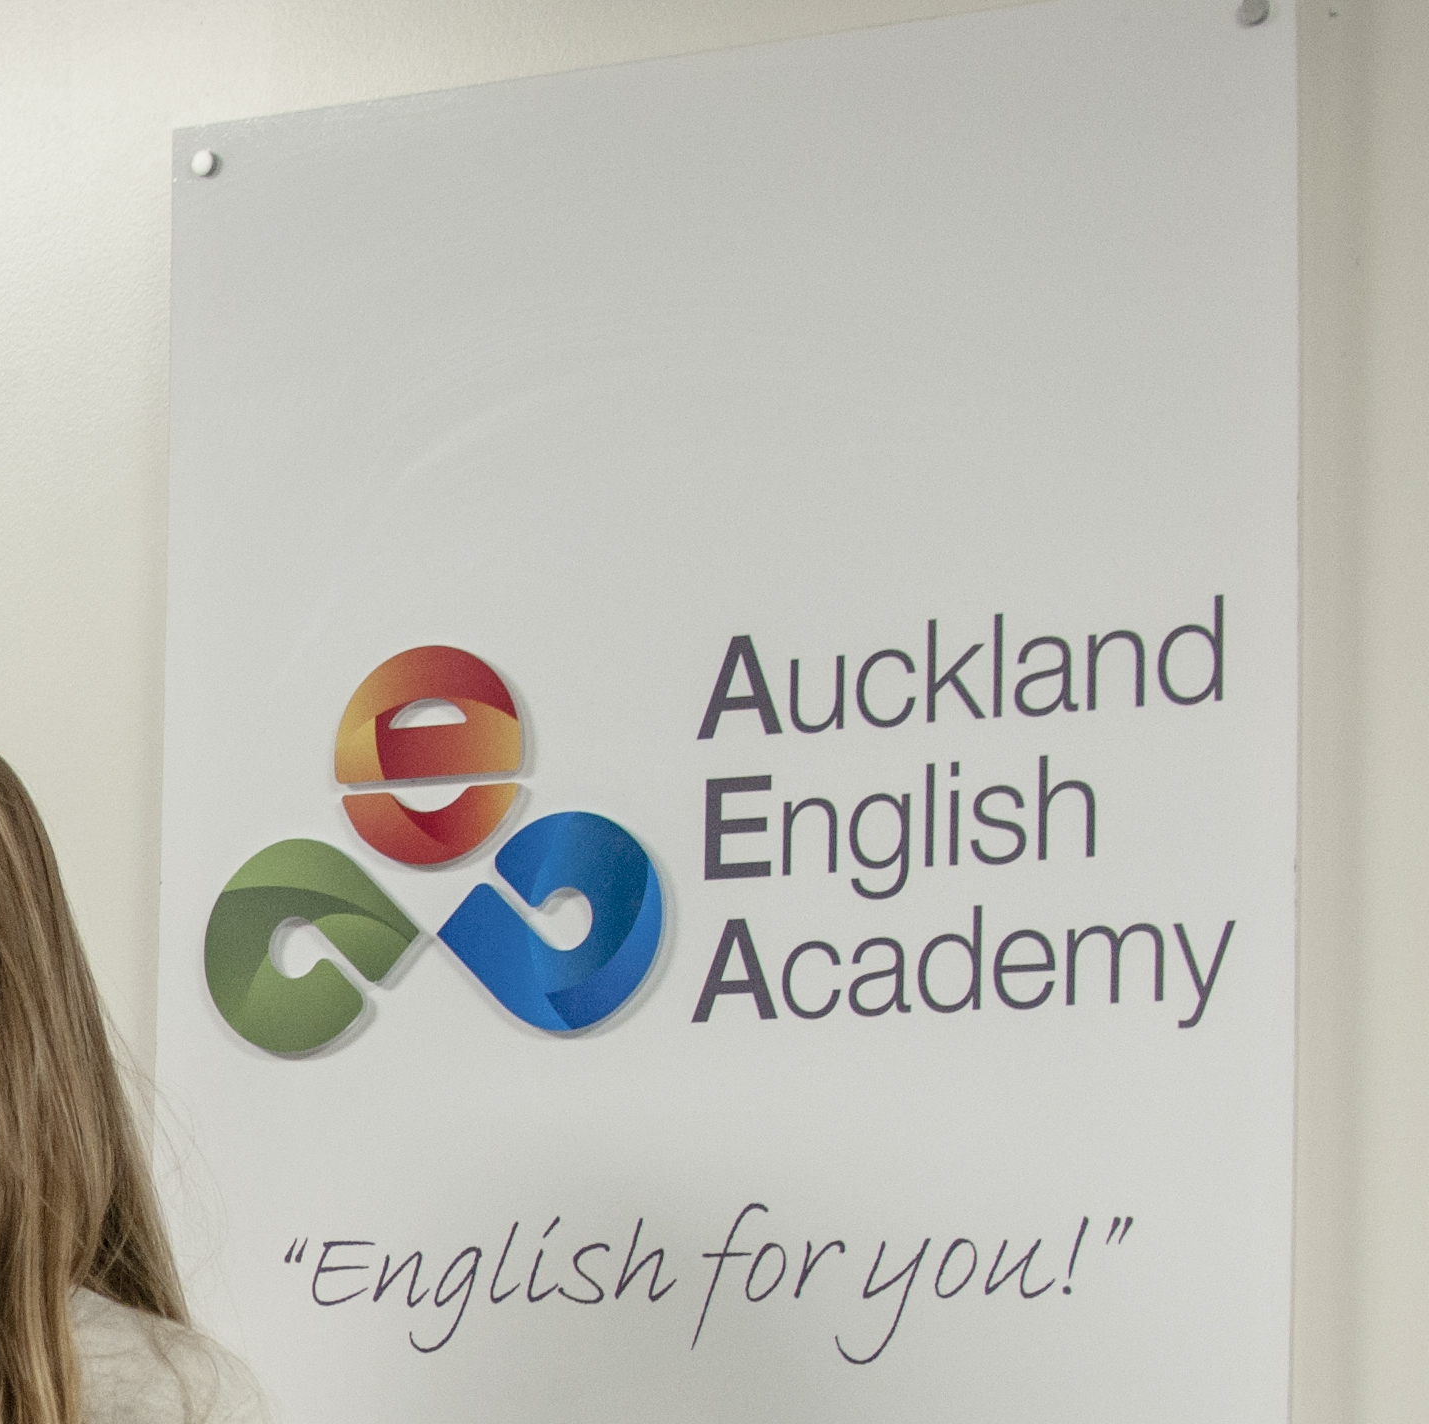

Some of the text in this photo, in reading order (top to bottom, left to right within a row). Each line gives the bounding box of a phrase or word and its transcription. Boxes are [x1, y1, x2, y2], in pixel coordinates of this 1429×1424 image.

[697, 595, 1224, 740] Auckland
[704, 755, 1096, 900] English
[691, 905, 1236, 1029] Academy
[692, 1203, 846, 1350] for
